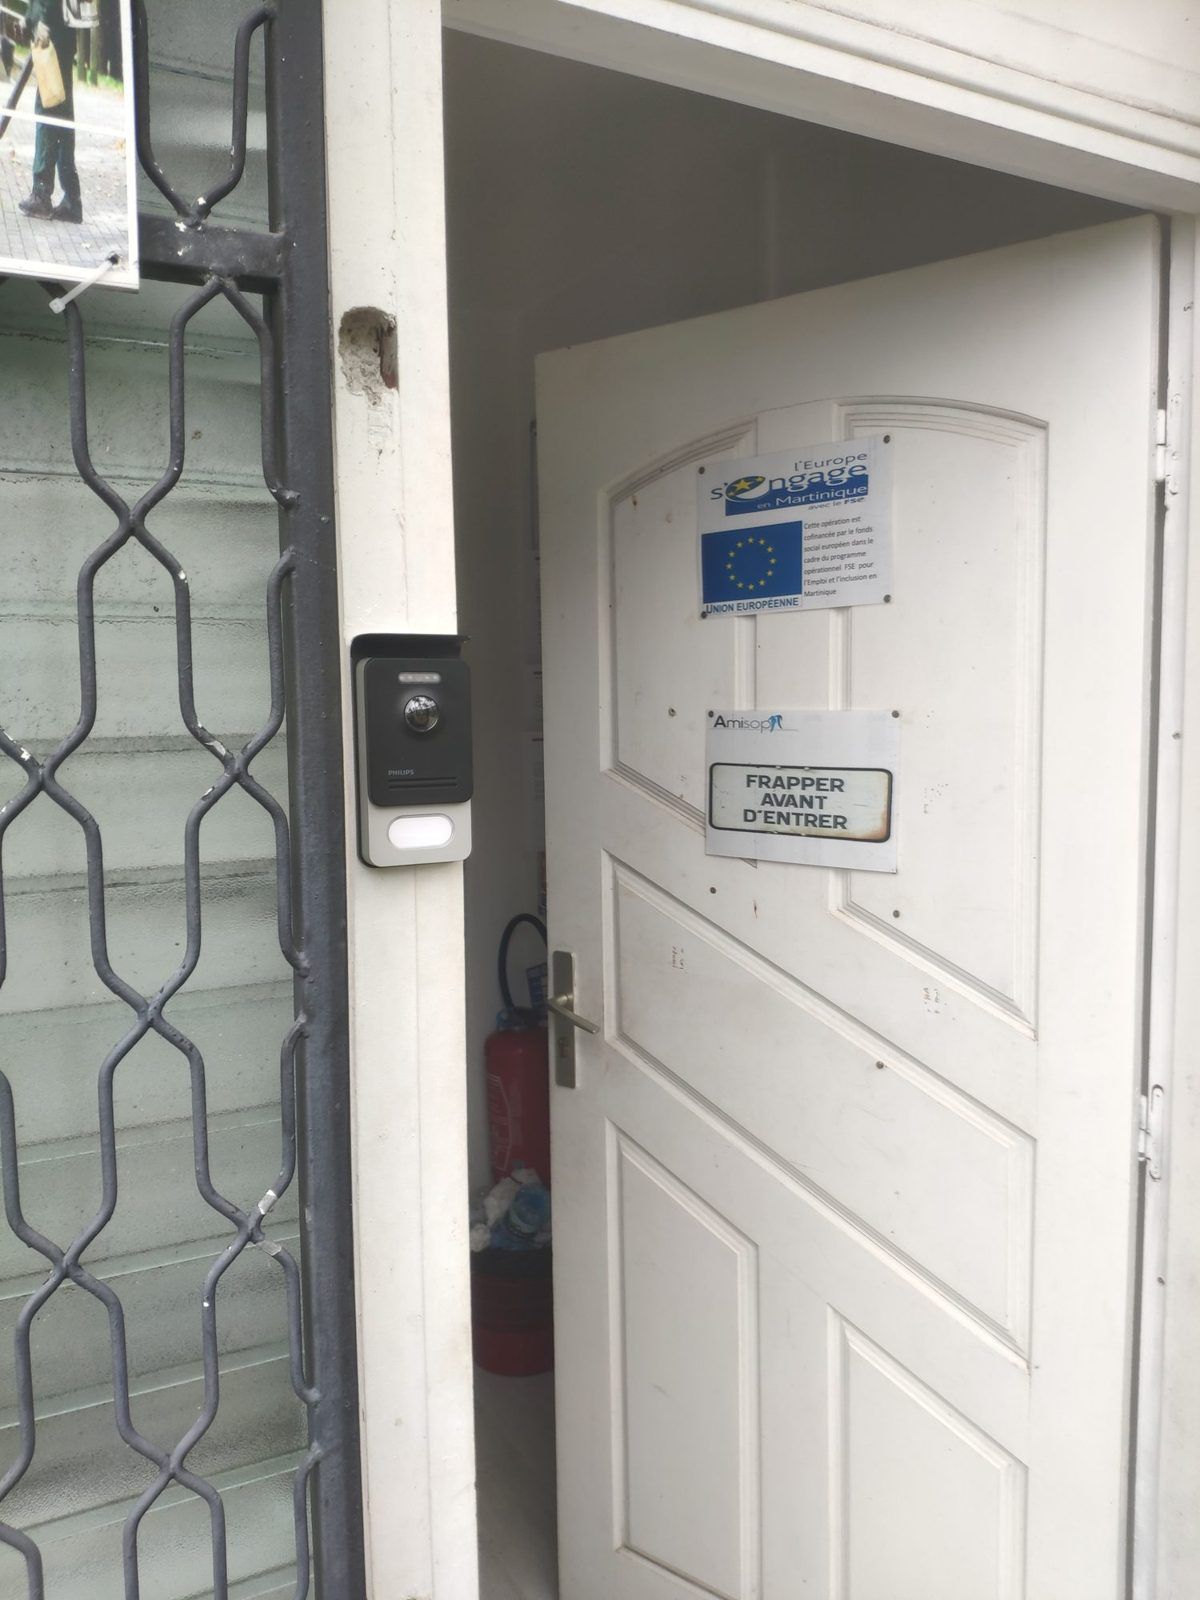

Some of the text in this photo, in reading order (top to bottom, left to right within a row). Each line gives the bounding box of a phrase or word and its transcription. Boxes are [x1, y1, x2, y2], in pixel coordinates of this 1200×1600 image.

[794, 453, 868, 471] l'Europe
[776, 486, 867, 506] Martinique
[821, 518, 850, 527] opération
[804, 532, 835, 540] cofinancée
[822, 542, 850, 550] européen
[830, 551, 866, 560] programme
[804, 565, 841, 574] opérationnel
[804, 589, 837, 597] Martinique
[706, 604, 734, 613] UNION
[714, 715, 771, 733] Amisop
[746, 775, 845, 792] FRAPPER
[760, 793, 828, 810] AVANT
[744, 810, 847, 829] D'ENTRER
